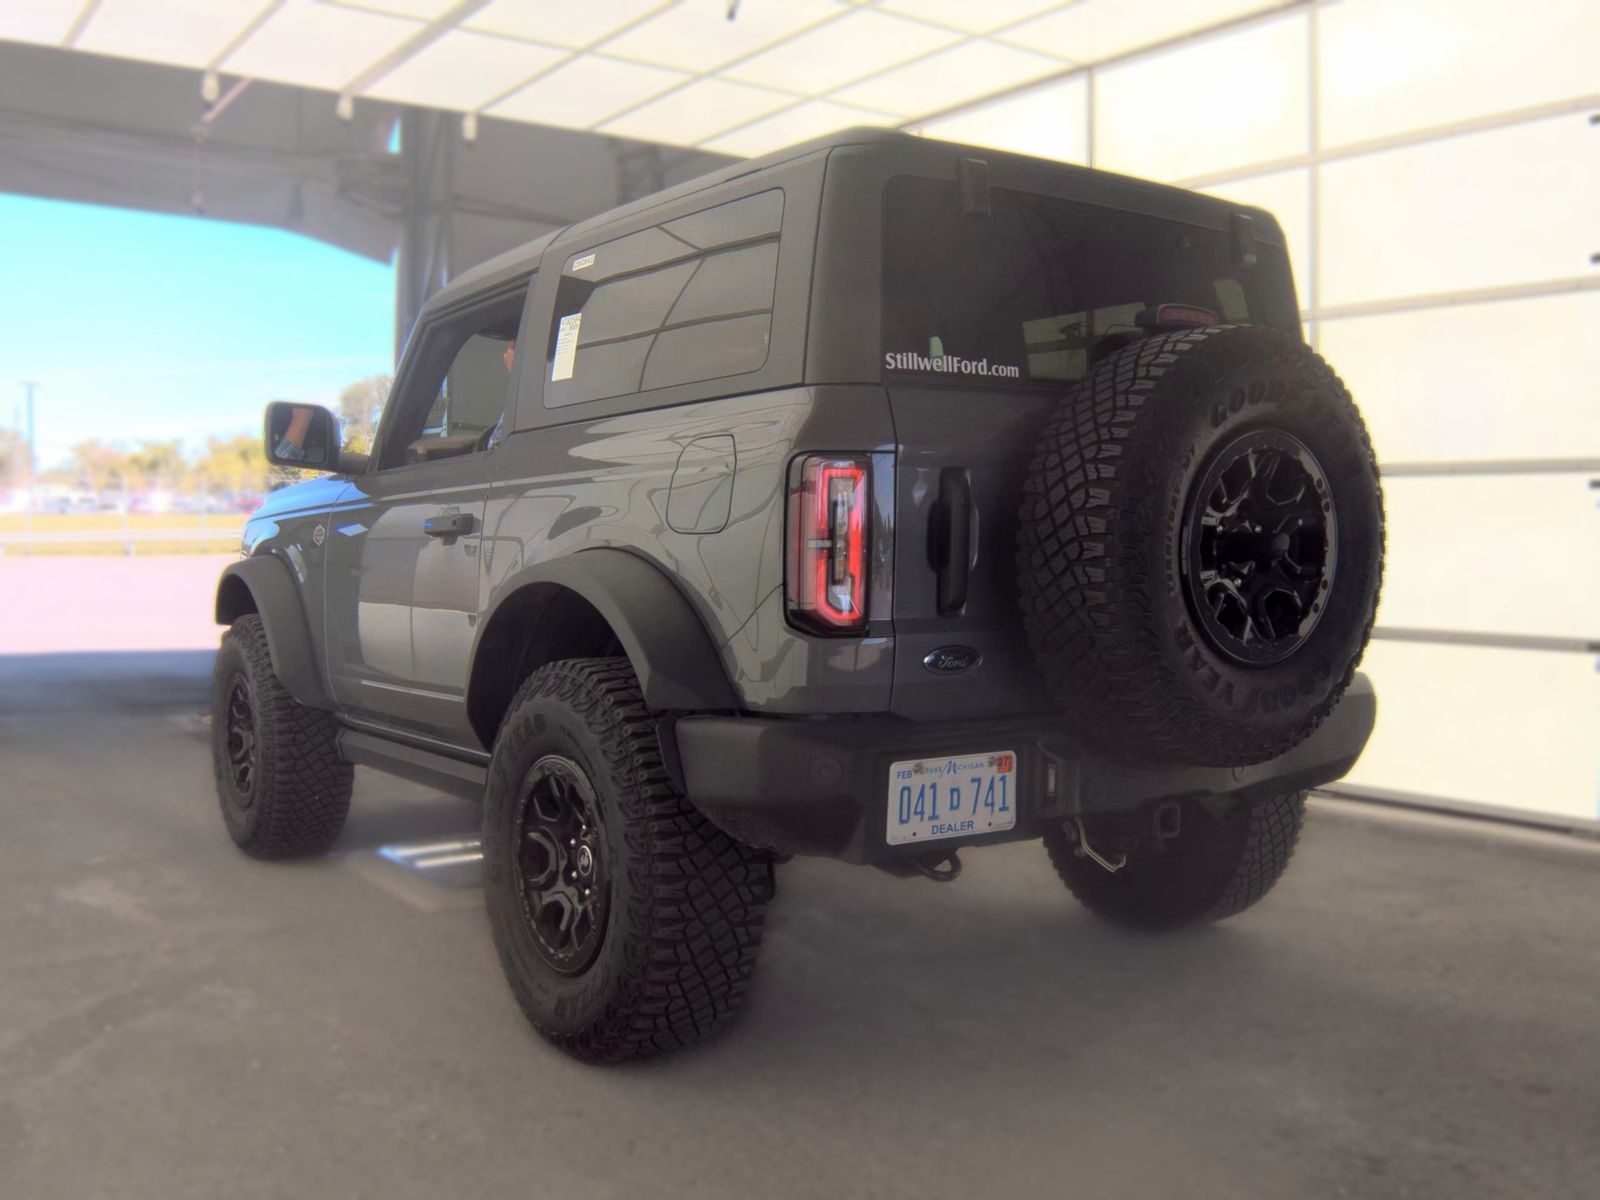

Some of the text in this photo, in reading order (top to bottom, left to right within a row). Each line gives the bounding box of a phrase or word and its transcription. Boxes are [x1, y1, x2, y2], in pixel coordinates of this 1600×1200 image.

[885, 352, 1020, 378] StillwellFord.com
[896, 770, 913, 780] FEB
[898, 775, 1010, 825] 041 D 741
[931, 820, 975, 835] DEALER
